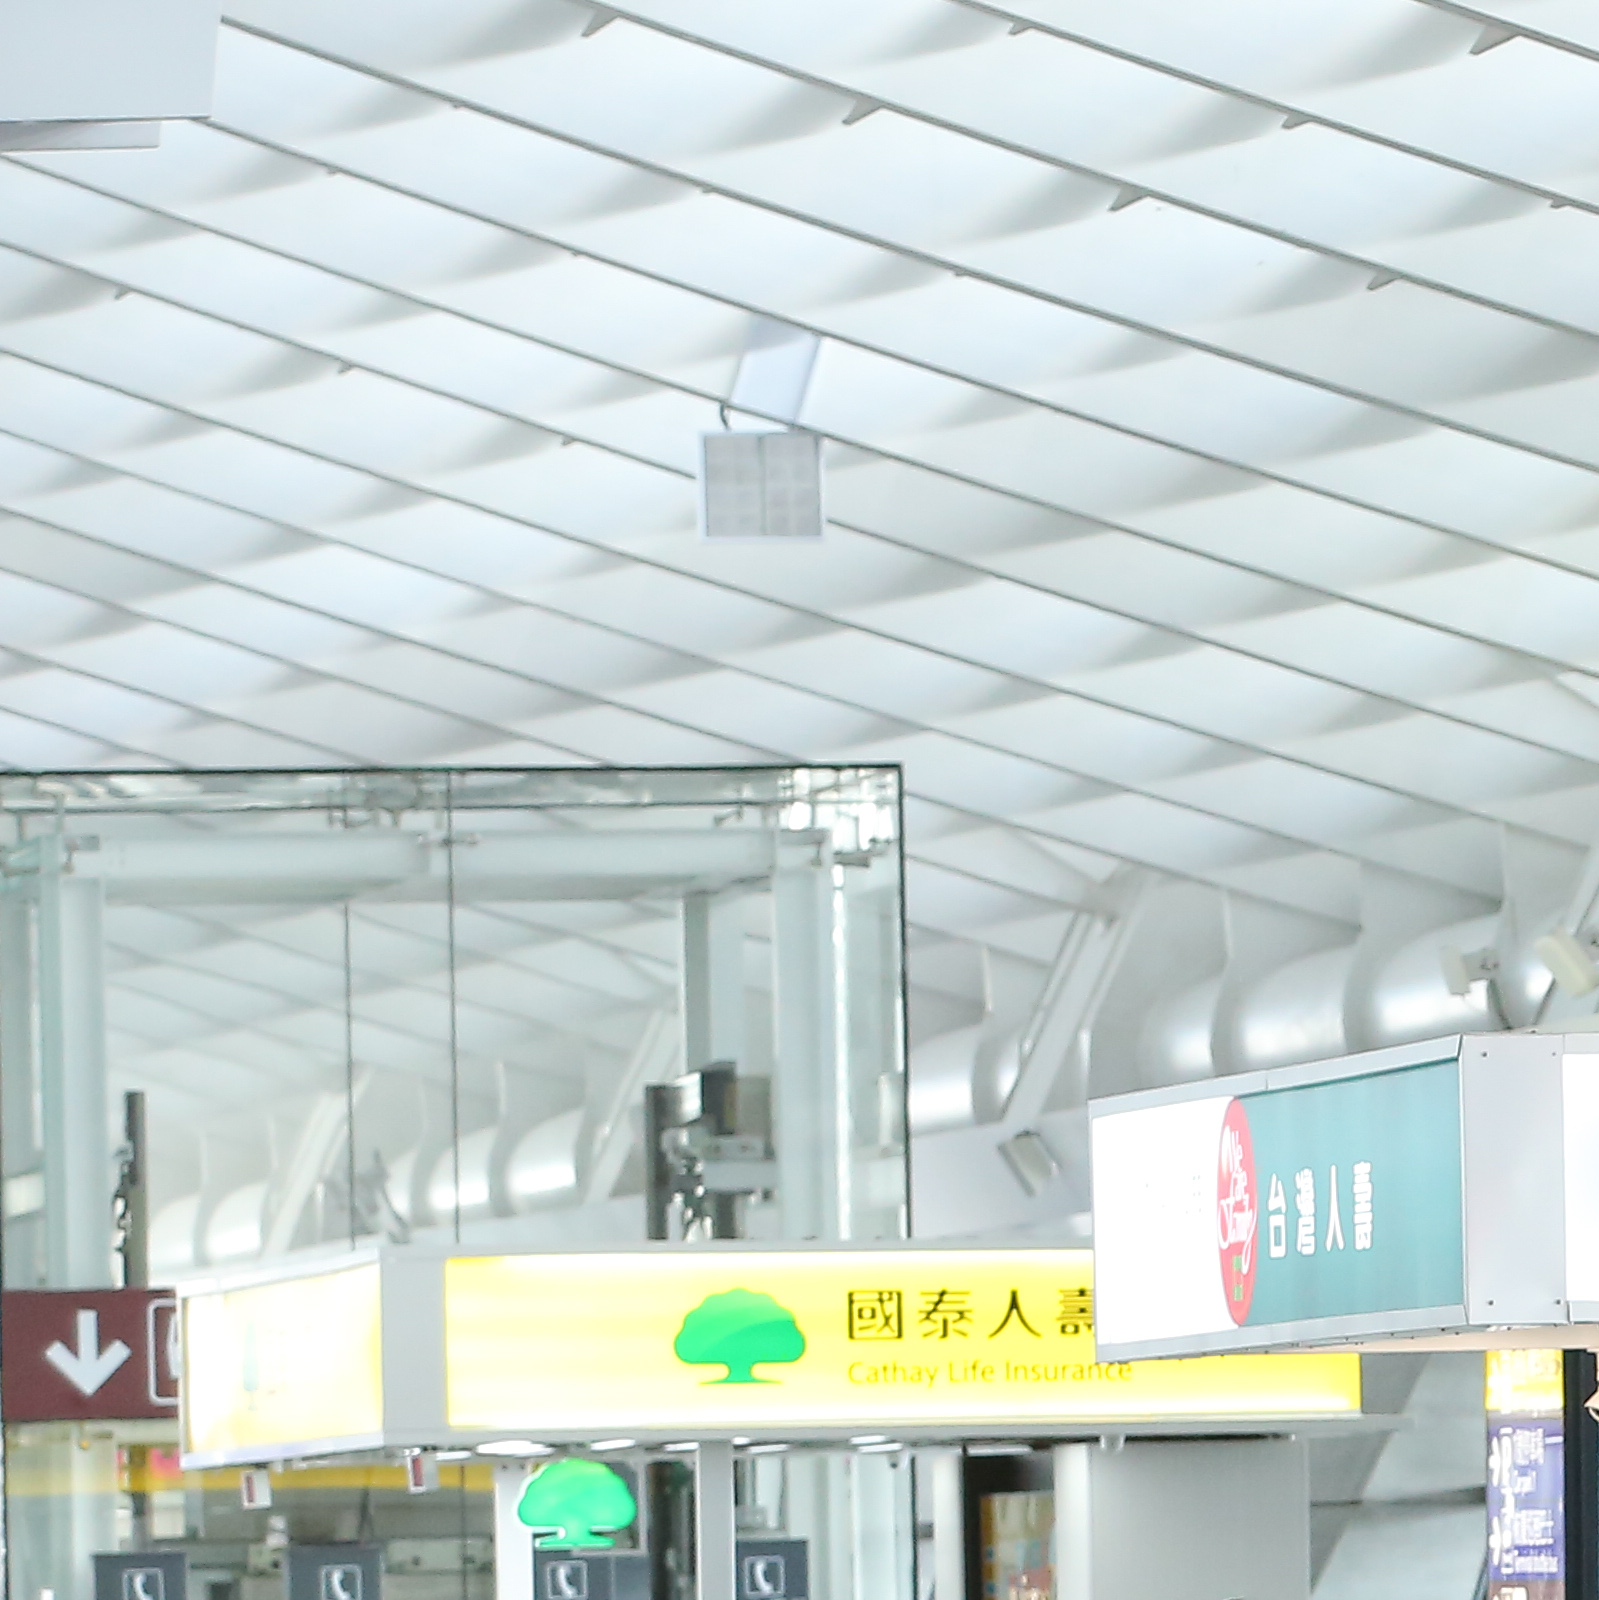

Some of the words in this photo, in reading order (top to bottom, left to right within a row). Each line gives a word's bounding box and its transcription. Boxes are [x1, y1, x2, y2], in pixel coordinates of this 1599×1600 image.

[1267, 1160, 1374, 1259] 台灣人壽
[847, 1288, 1095, 1340] 國泰人壽
[848, 1359, 939, 1387] Cathay
[948, 1358, 995, 1382] Life
[1005, 1360, 1133, 1382] Insurance
